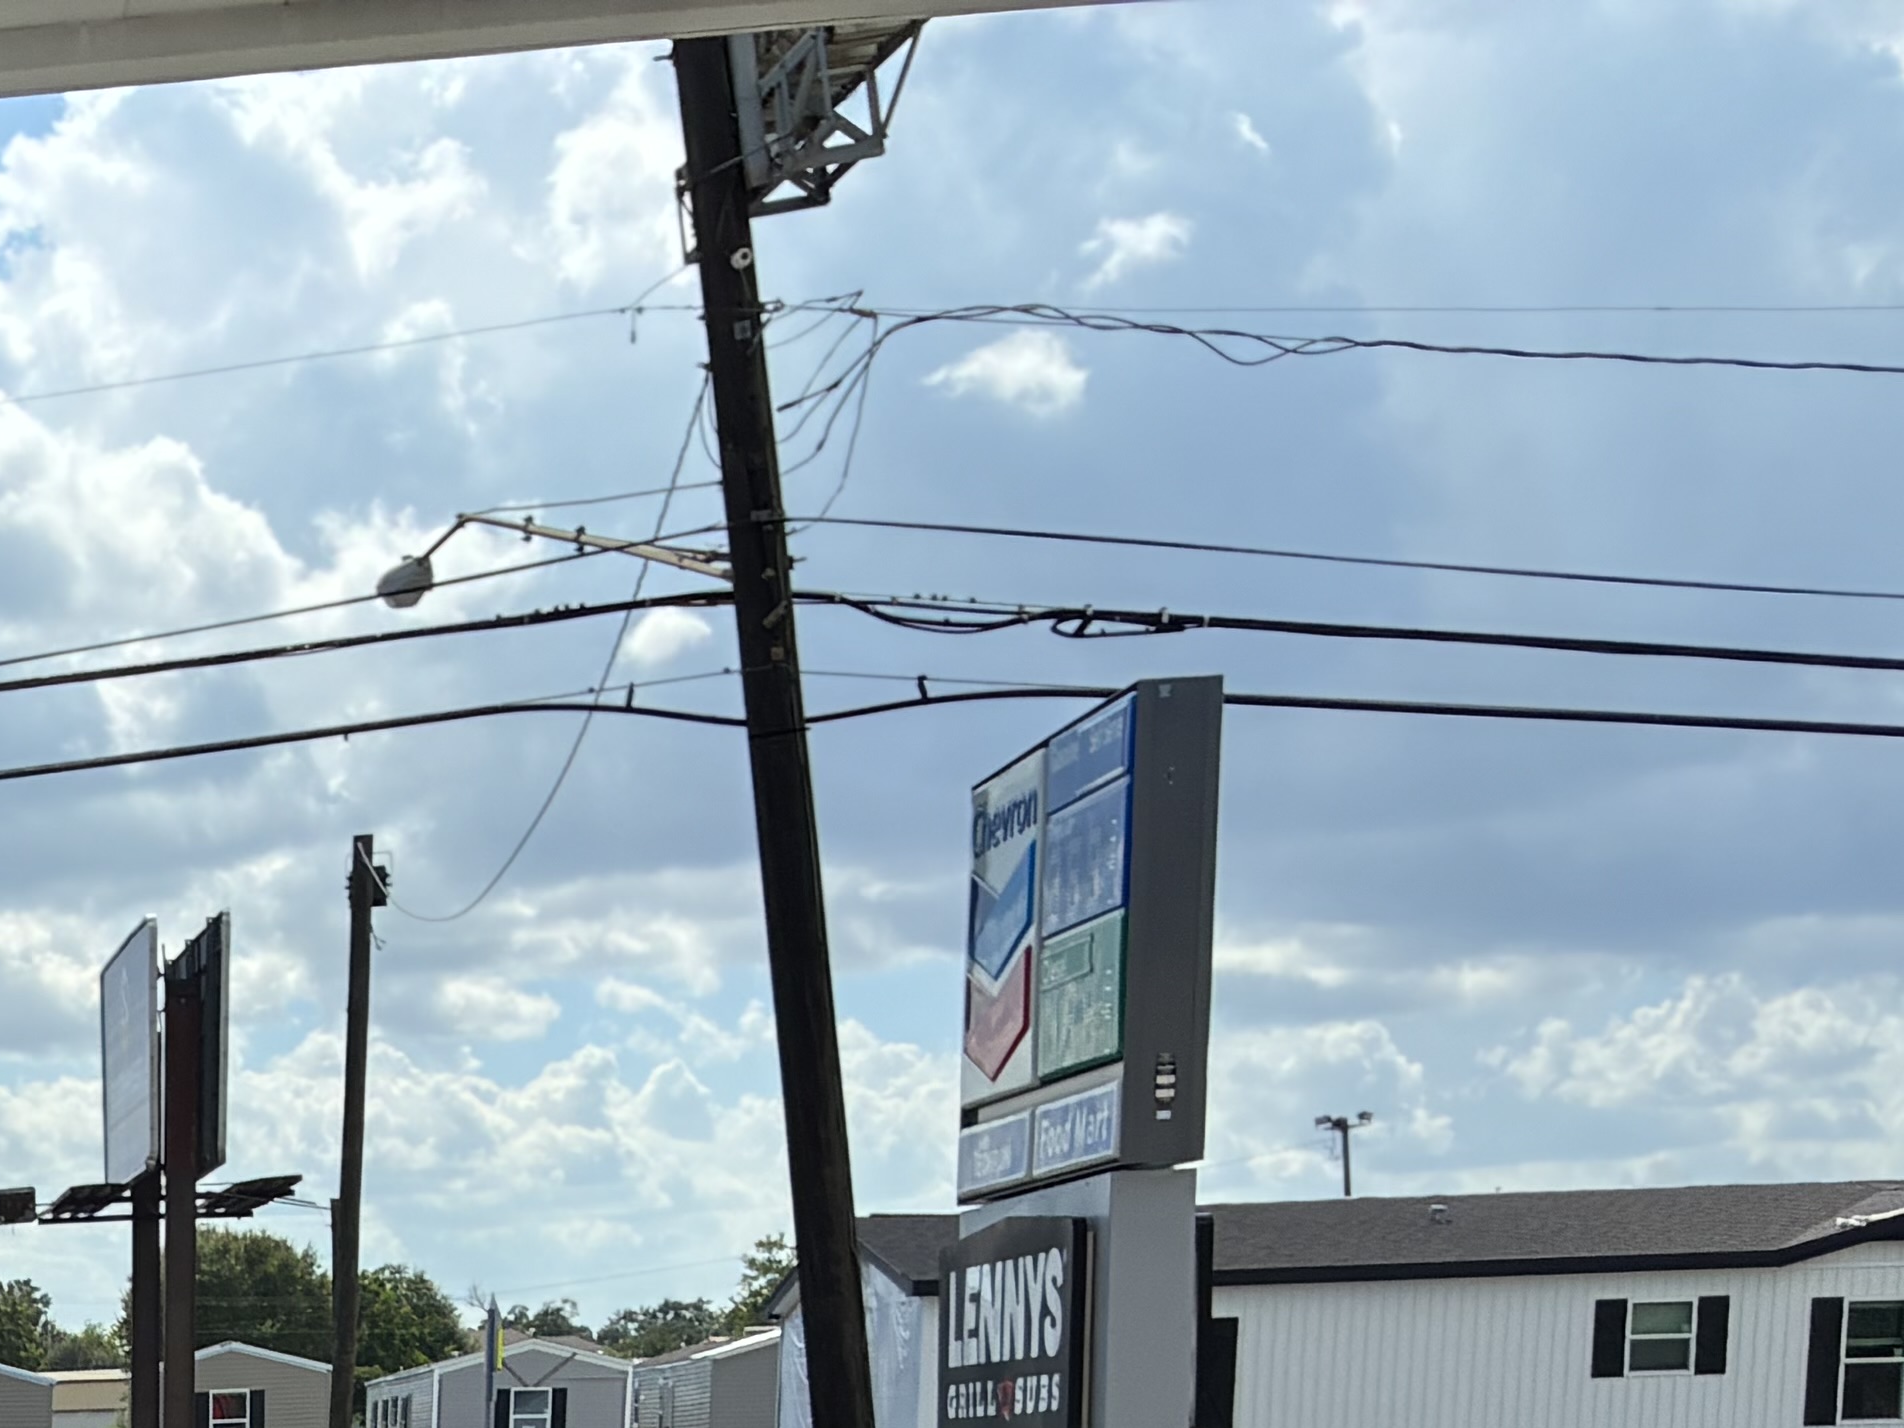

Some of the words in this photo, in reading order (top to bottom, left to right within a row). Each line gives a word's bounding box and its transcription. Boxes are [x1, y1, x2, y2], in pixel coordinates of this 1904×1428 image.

[973, 788, 1038, 860] Chevron
[948, 1247, 1065, 1369] LENNYS
[947, 1379, 996, 1420] GRILL
[1014, 1372, 1061, 1416] SUBS
